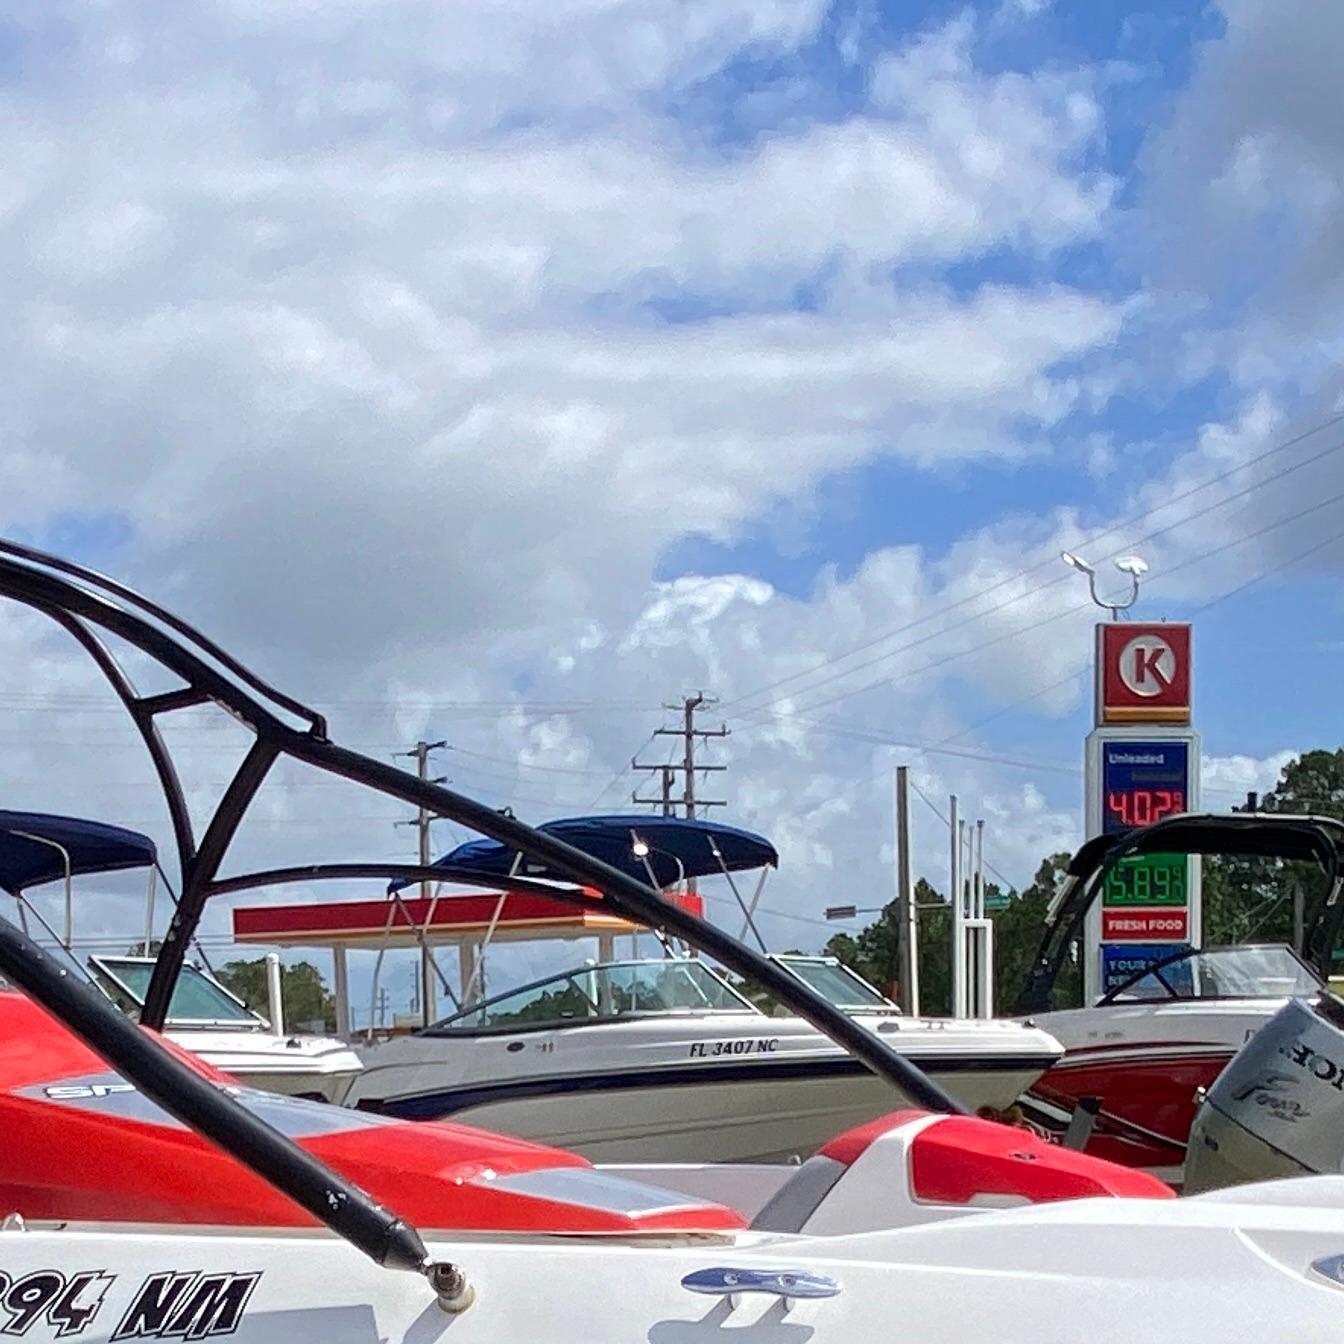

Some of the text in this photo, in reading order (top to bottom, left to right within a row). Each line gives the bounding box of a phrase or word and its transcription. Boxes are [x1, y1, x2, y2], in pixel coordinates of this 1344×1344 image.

[1109, 753, 1165, 764] Unleaded
[1108, 919, 1183, 931] FRESH FOOD
[690, 1038, 779, 1058] FL 3407 NC
[110, 1270, 263, 1342] NM
